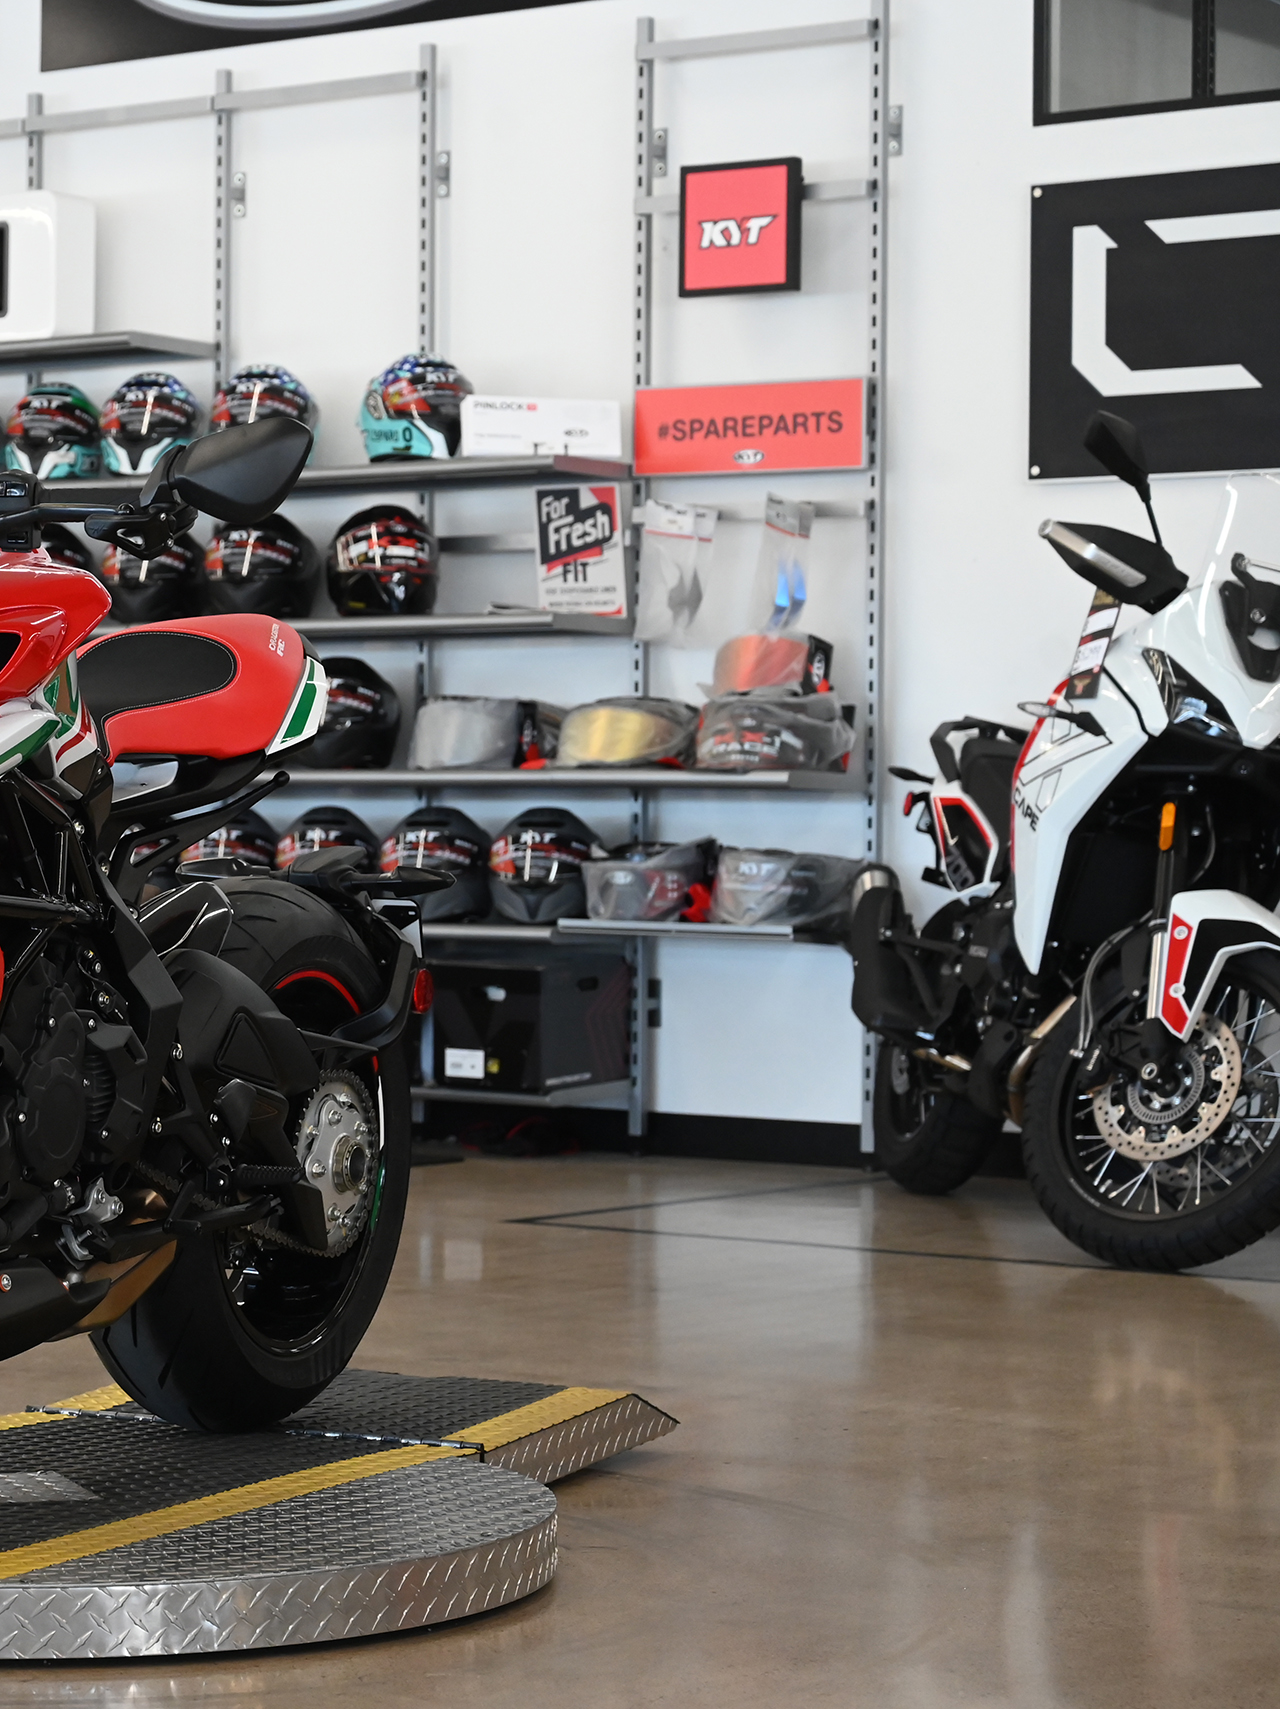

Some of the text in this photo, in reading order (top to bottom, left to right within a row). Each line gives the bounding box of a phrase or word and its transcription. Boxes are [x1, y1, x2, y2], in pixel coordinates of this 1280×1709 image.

[658, 410, 843, 442] #SPAREPARTS
[541, 495, 570, 523] For
[548, 509, 611, 555] Fresh
[563, 559, 589, 583] FIT
[1013, 787, 1040, 832] CAPE
